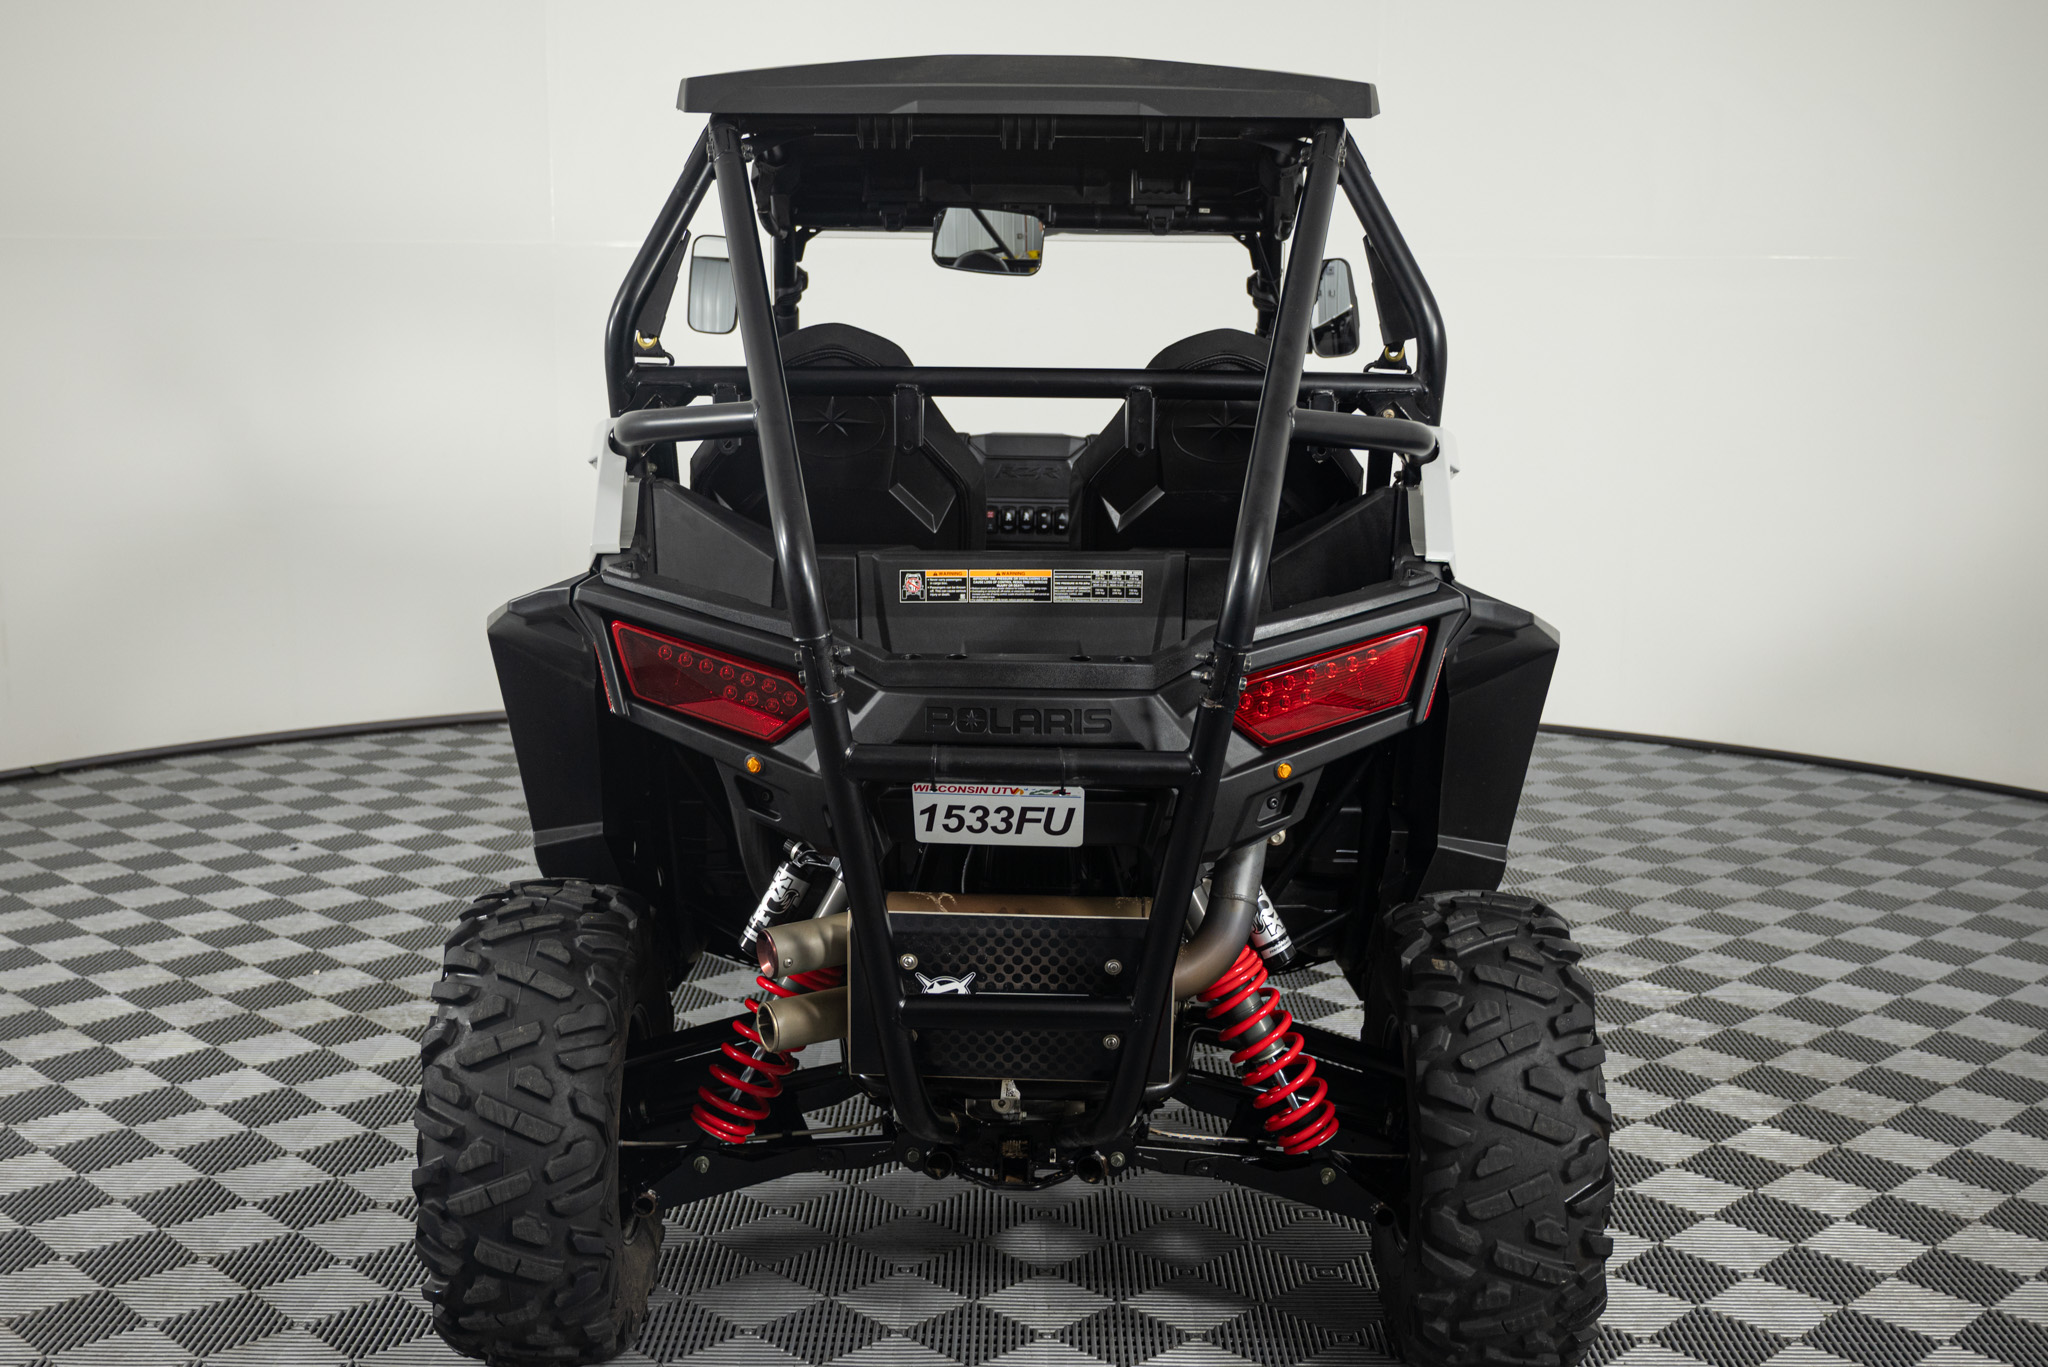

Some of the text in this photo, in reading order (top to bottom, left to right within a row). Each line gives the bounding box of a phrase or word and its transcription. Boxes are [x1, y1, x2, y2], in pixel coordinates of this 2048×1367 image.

[924, 706, 1112, 735] POLARIS
[991, 786, 1019, 795] UTV
[919, 803, 1076, 836] 1533FU
